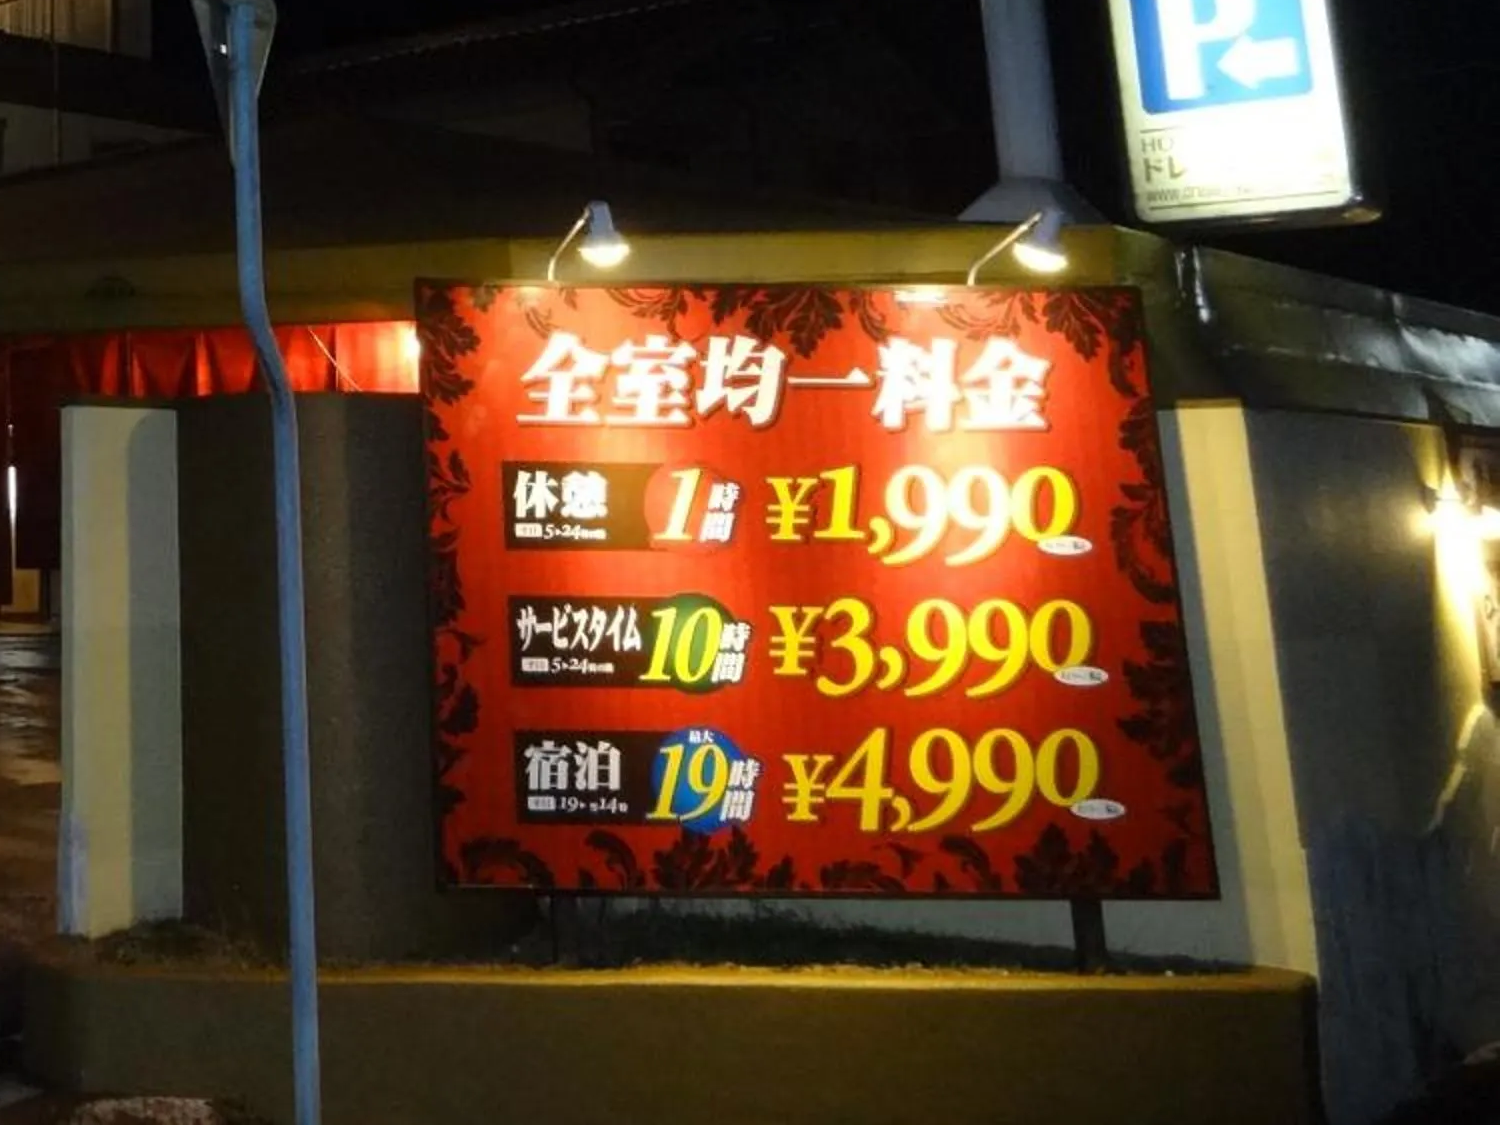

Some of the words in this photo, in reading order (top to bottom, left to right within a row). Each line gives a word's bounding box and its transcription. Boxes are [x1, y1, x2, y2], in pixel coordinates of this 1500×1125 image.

[516, 332, 1052, 432] 全室均一料金
[513, 469, 608, 520] 休憩
[764, 465, 1076, 565] ¥1,990
[768, 597, 1092, 698] ¥3,990
[523, 740, 622, 792] 宿泊
[781, 727, 1100, 832] ¥4,990
